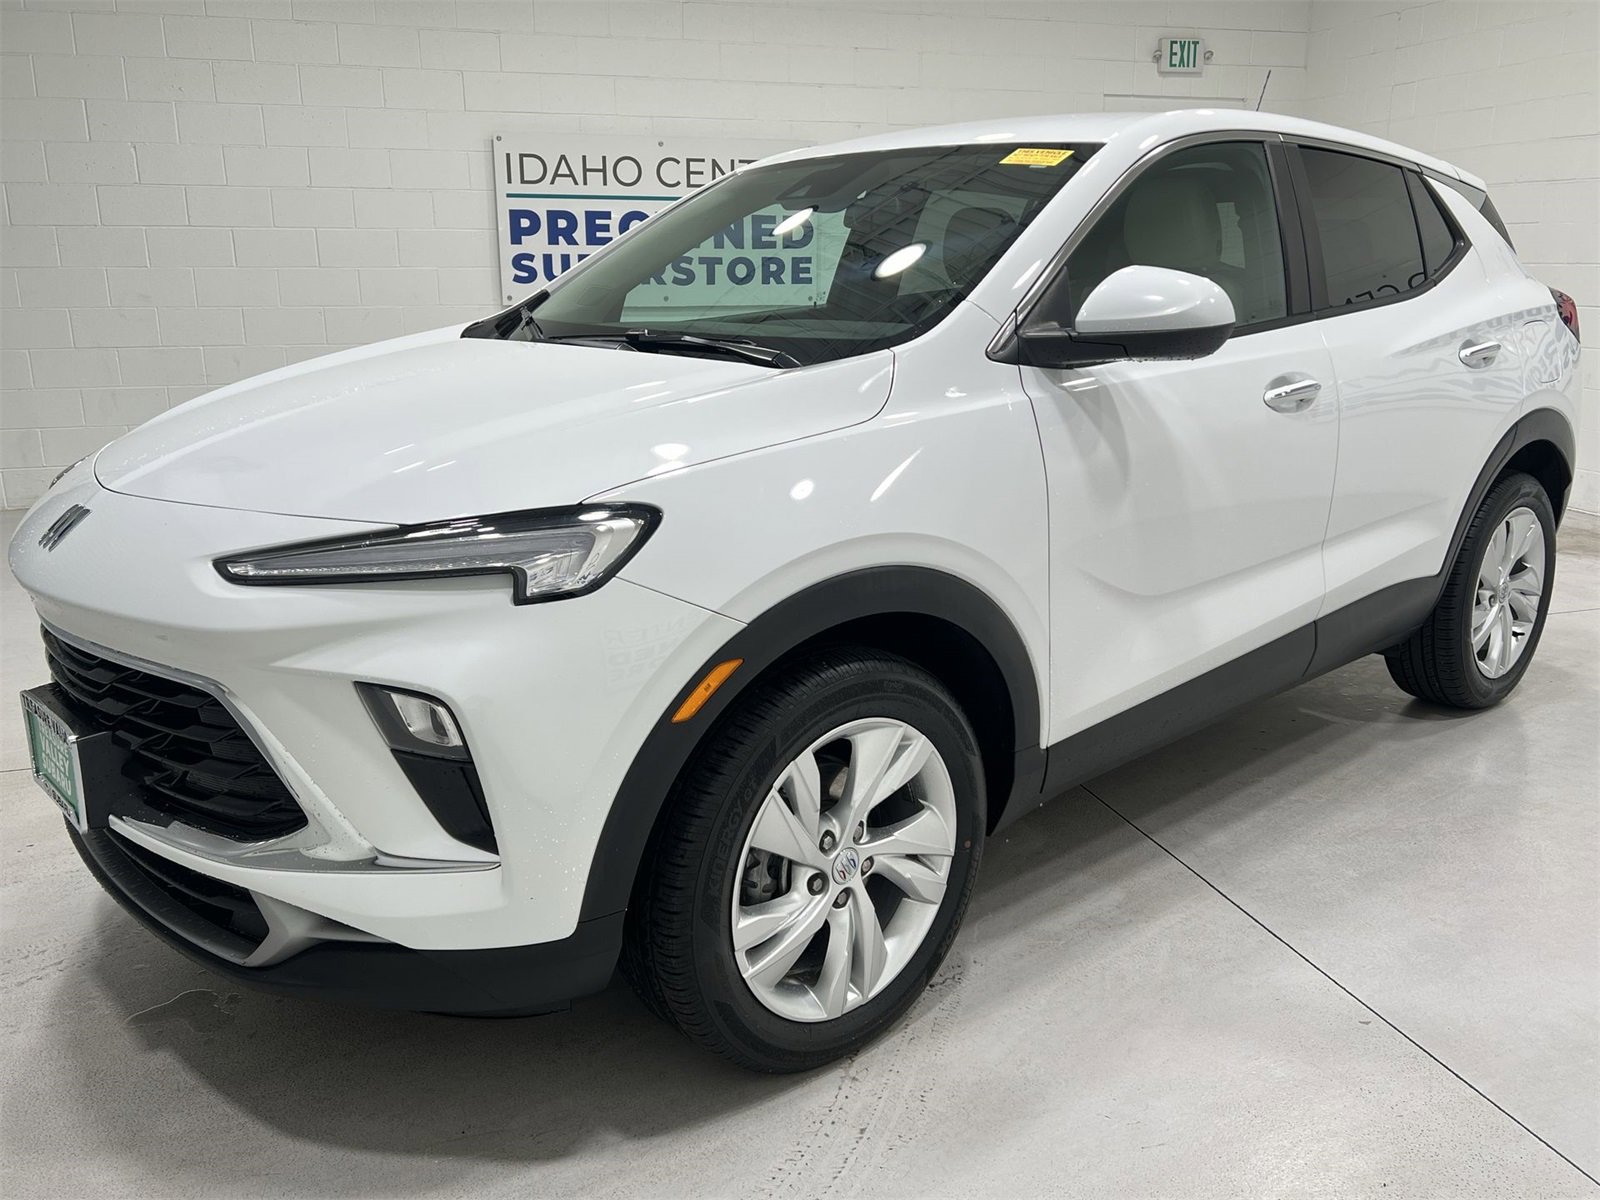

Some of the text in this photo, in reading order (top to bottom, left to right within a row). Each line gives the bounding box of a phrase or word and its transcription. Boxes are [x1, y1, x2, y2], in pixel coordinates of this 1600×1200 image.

[1169, 40, 1200, 68] EXIT
[505, 153, 643, 188] IDAHO
[508, 209, 815, 250] PRENED
[511, 252, 813, 287] SUSTORE
[40, 733, 70, 778] VALLEY
[41, 751, 72, 797] SUBARU
